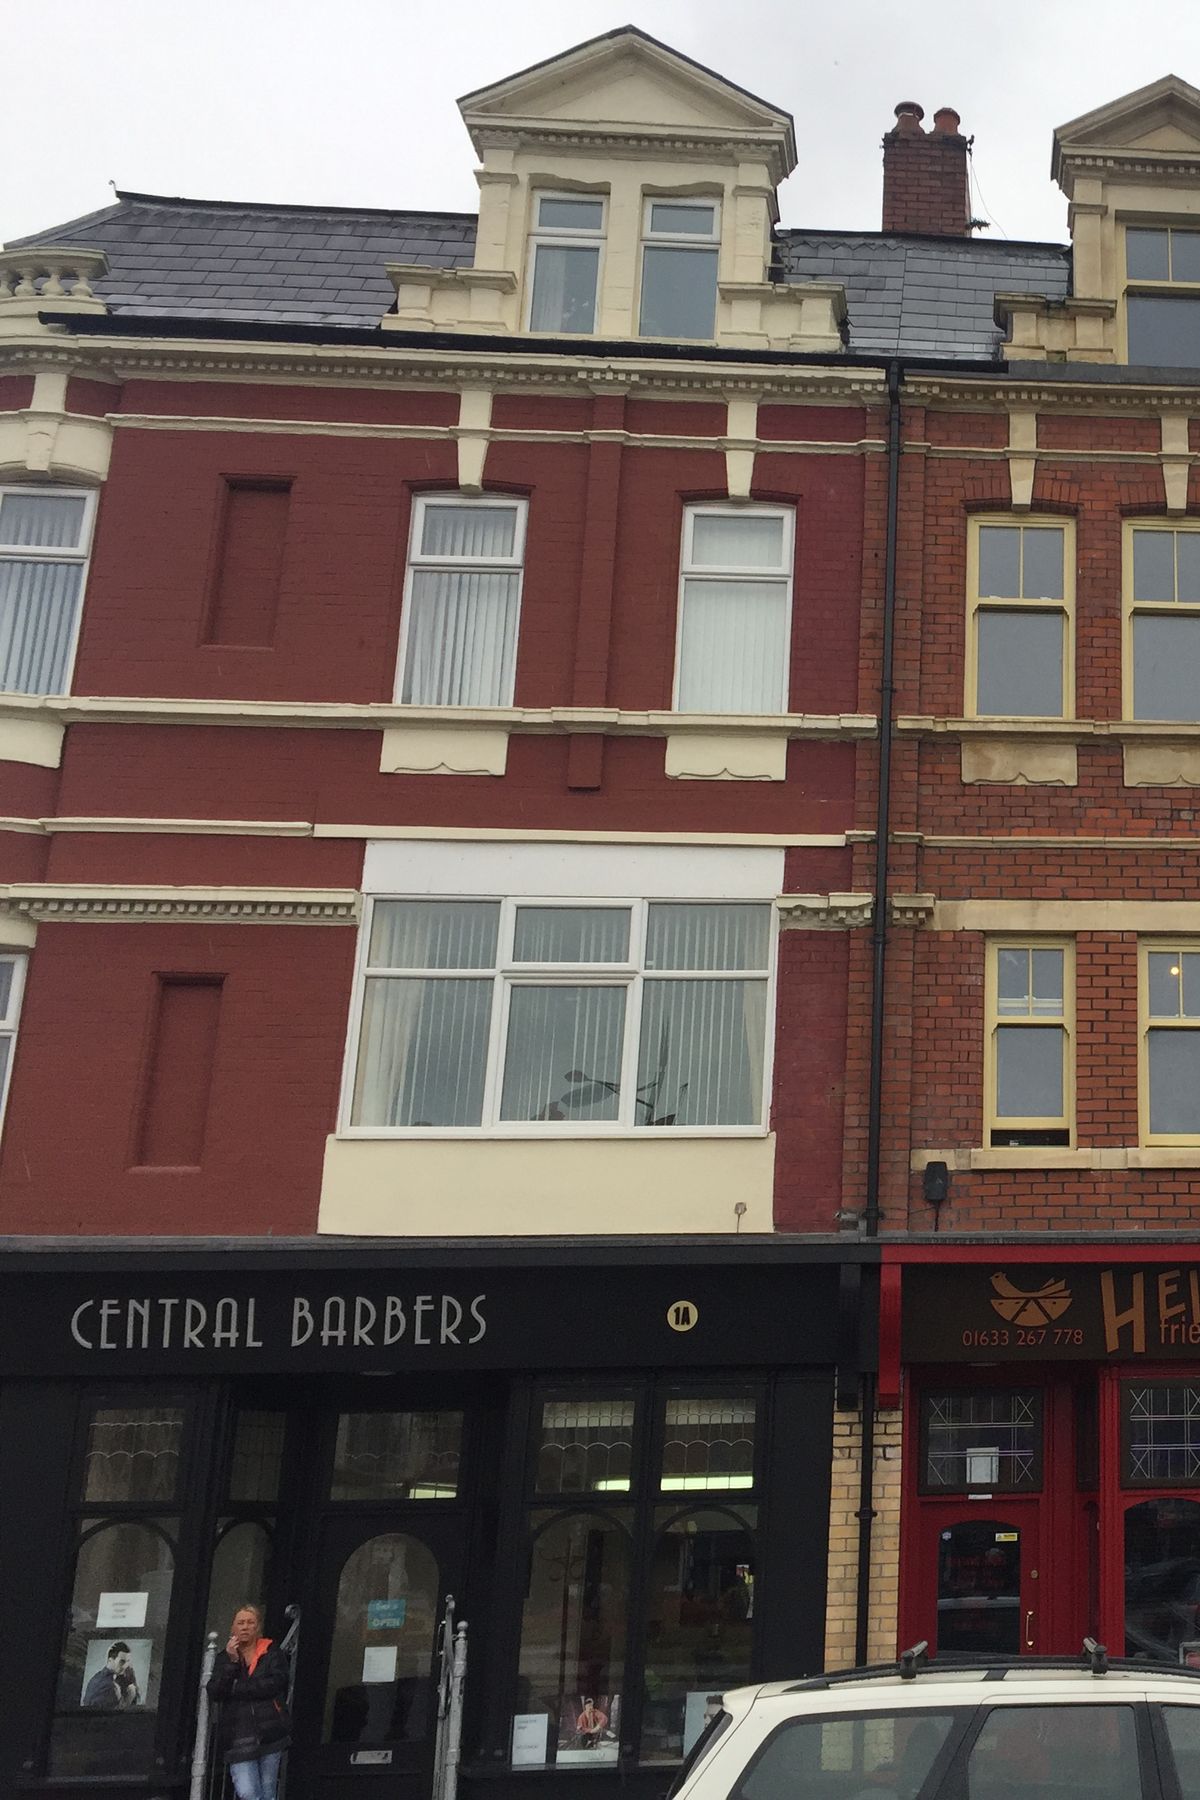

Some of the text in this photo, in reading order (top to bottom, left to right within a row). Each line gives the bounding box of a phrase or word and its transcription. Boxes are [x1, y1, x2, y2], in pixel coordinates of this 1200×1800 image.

[71, 1294, 488, 1349] CENTRAL BARBERS
[674, 1306, 690, 1325] 1A
[962, 1328, 1084, 1346] 01633 267 778
